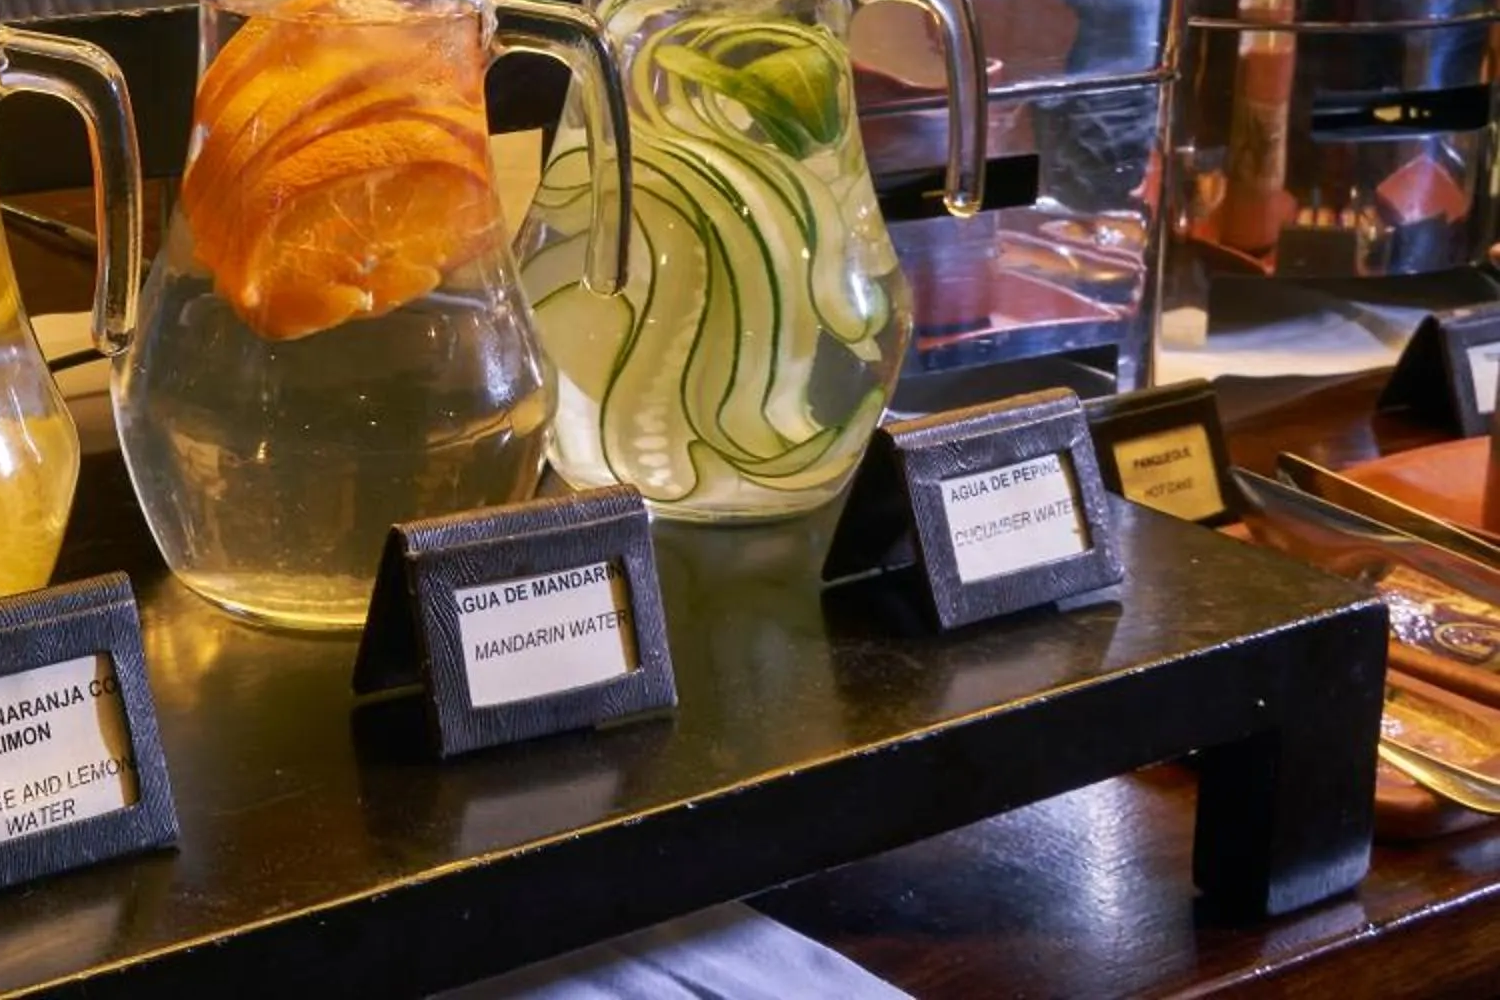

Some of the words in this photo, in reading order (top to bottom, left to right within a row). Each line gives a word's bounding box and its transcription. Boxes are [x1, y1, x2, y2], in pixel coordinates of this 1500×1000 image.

[951, 480, 990, 504] AGUA
[990, 473, 1011, 491] DE
[954, 511, 1031, 547] CUCUMBER
[1033, 499, 1074, 522] WATE
[504, 583, 529, 603] DE
[475, 623, 565, 661] MANDARIN
[568, 609, 629, 638] WATER
[21, 775, 62, 804] AND
[5, 798, 76, 837] WATER
